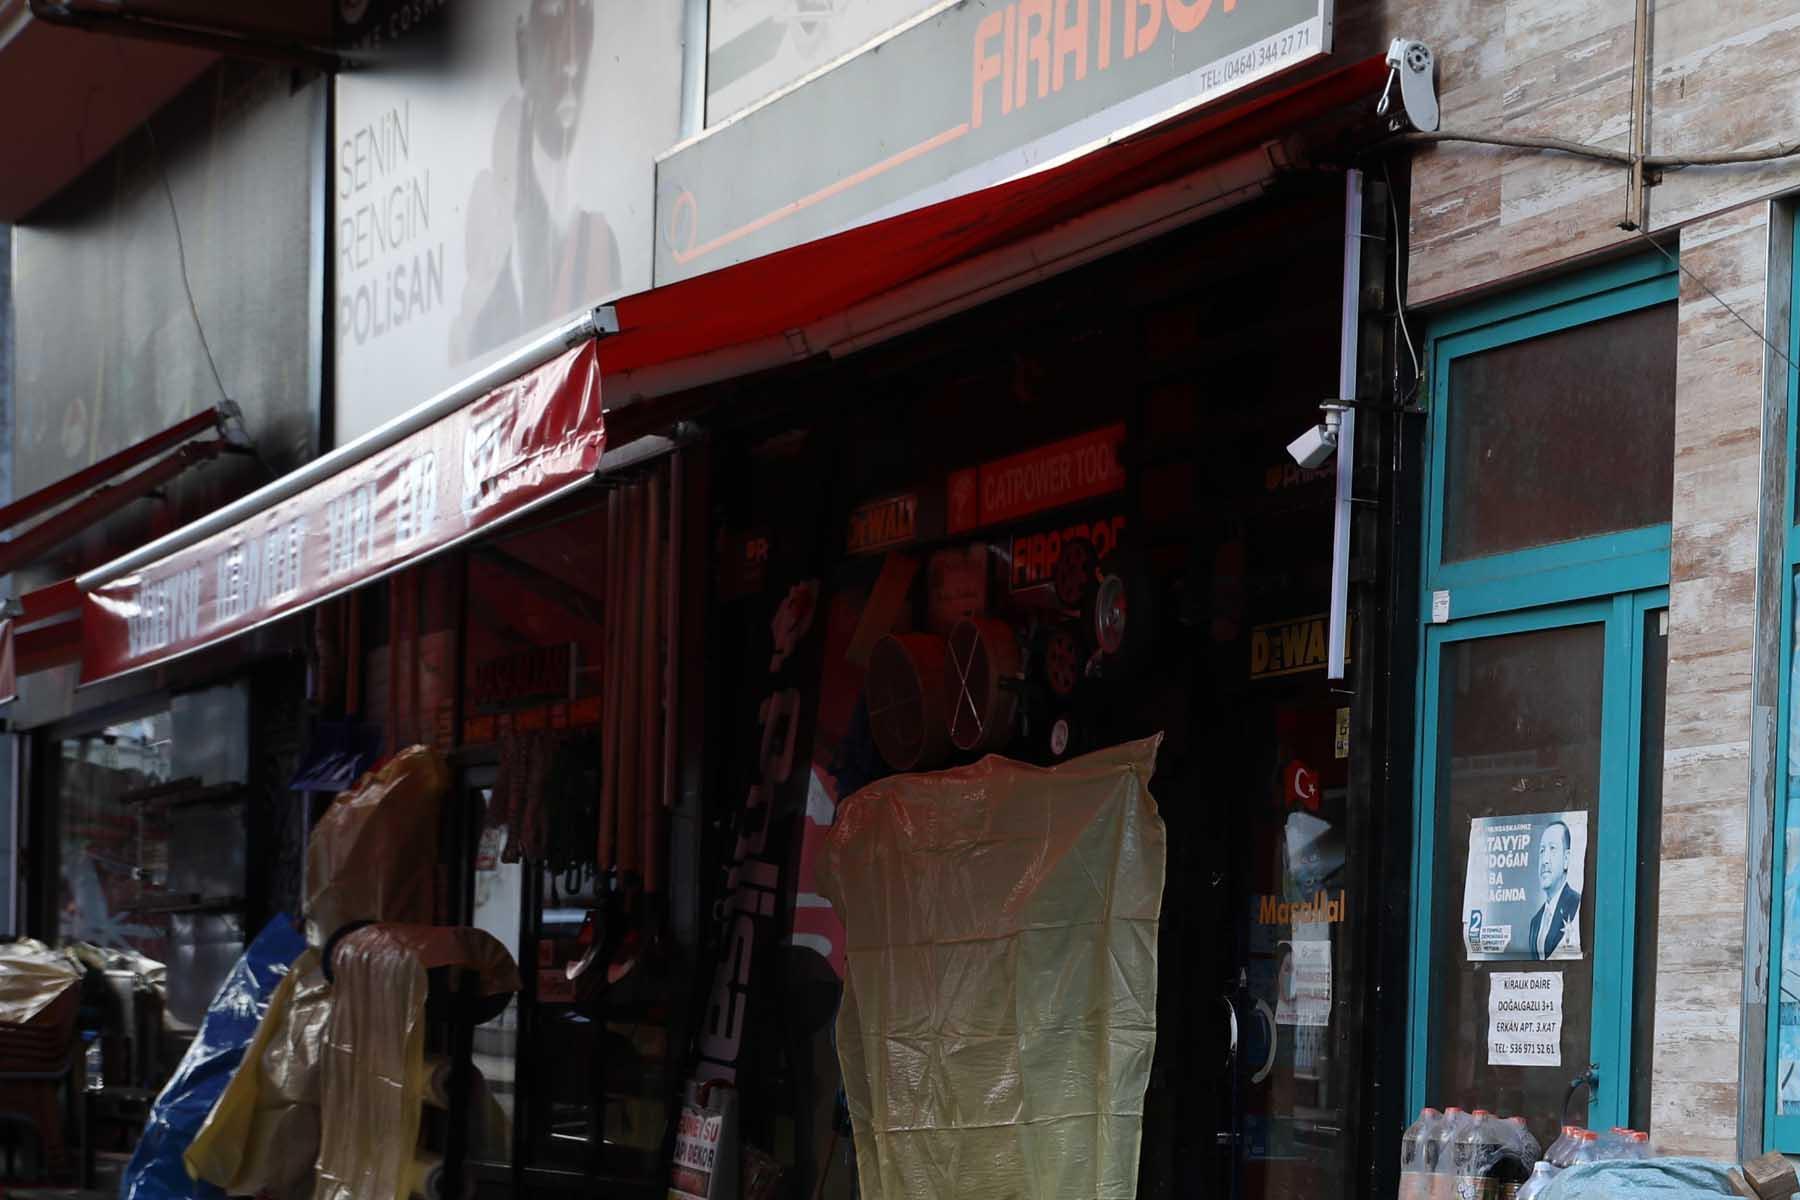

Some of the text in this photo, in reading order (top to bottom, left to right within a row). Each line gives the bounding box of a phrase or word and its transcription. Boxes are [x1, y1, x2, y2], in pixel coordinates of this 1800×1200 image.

[1224, 54, 1257, 83] (0464)
[1258, 44, 1278, 67] 344
[1280, 38, 1295, 58] 27
[1297, 27, 1311, 51] 71
[1504, 977, 1551, 990] KİRALIK DAİRE
[1497, 999, 1554, 1011] DOĞALGAZLI 3+1
[1496, 1021, 1518, 1033] ERKAN
[1523, 1042, 1535, 1054] 971
[1546, 1042, 1555, 1054] 61
